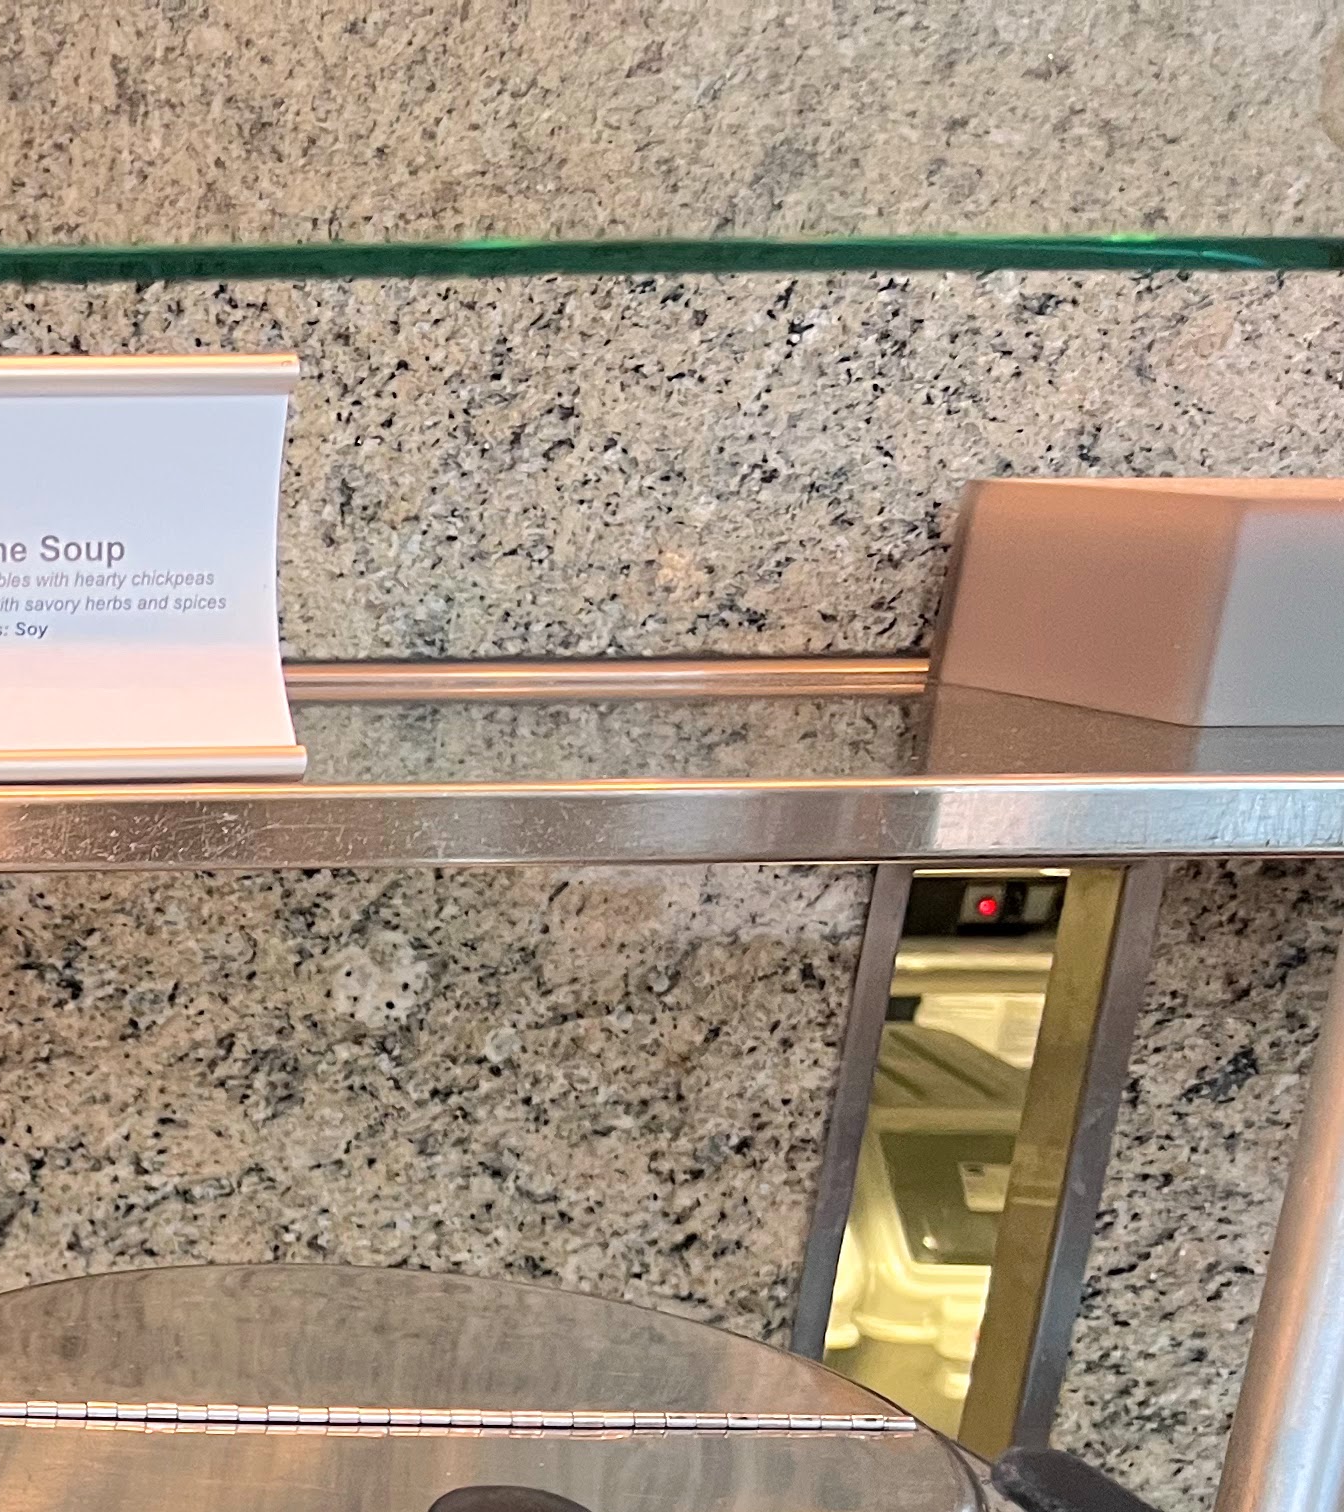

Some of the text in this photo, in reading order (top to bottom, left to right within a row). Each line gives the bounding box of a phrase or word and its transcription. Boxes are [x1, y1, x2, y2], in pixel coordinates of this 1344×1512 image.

[39, 534, 126, 569] Soup
[35, 571, 70, 588] with
[73, 570, 128, 590] hearty
[131, 568, 215, 590] chickpeas
[24, 597, 82, 616] savory
[84, 594, 133, 611] herbs
[136, 594, 170, 611] and
[172, 593, 227, 613] spices
[14, 620, 49, 640] Soy
